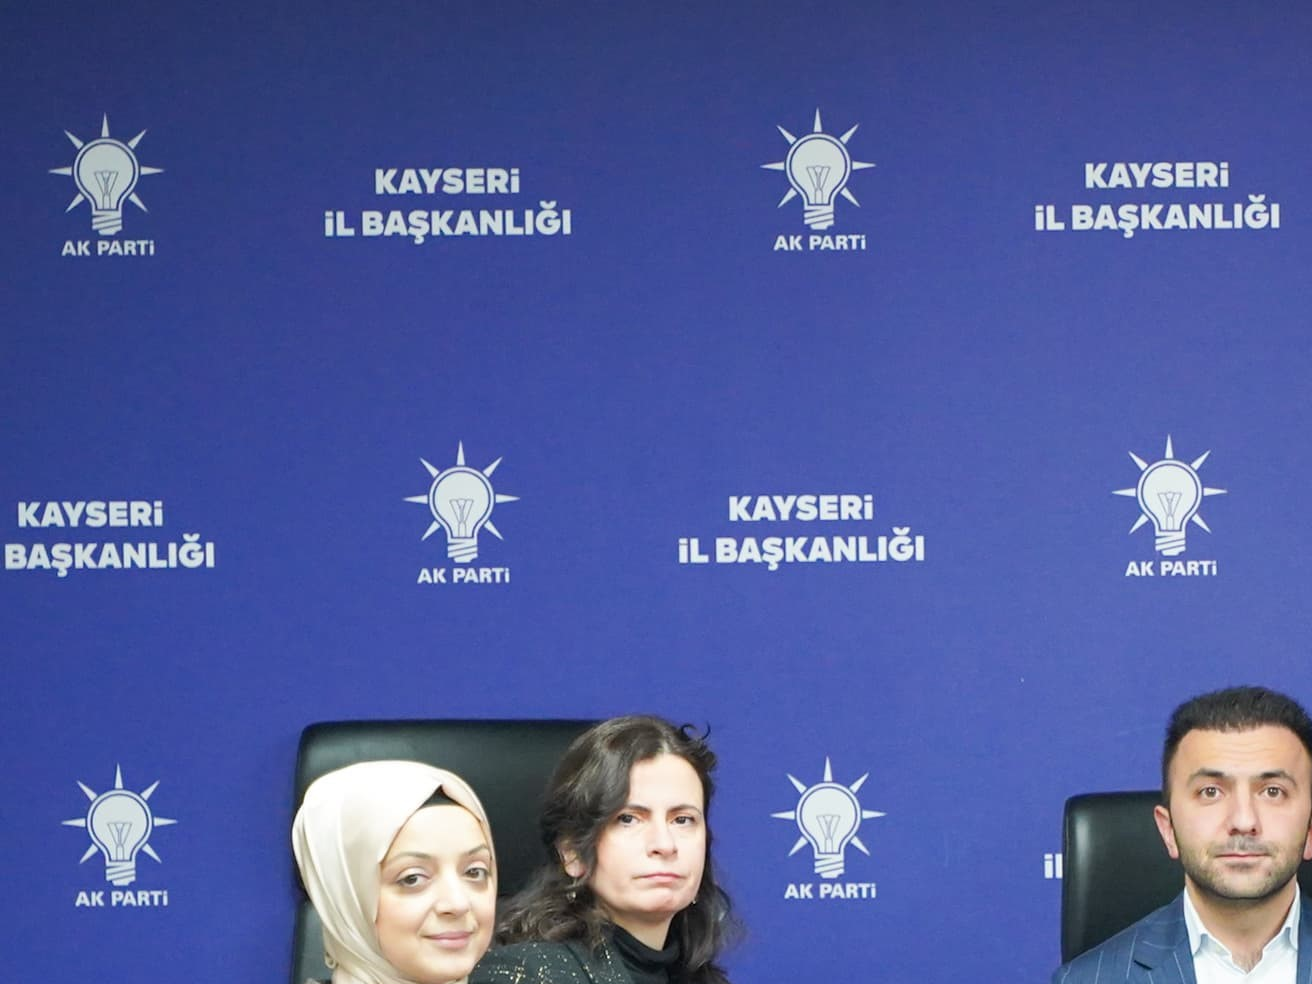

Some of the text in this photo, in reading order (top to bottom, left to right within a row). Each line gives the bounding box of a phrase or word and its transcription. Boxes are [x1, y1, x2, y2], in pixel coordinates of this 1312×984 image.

[362, 200, 572, 245] BAŞKANLIĞI
[1071, 194, 1280, 239] BAŞKANLIĞI
[61, 240, 91, 256] AK
[773, 235, 803, 251] AK
[4, 533, 215, 578] BAŞKANLIĞI
[715, 526, 925, 571] BAŞKANLIĞI
[417, 567, 447, 584] AK
[1125, 561, 1154, 577] AK
[75, 891, 105, 907] AK
[784, 883, 814, 899] AK
